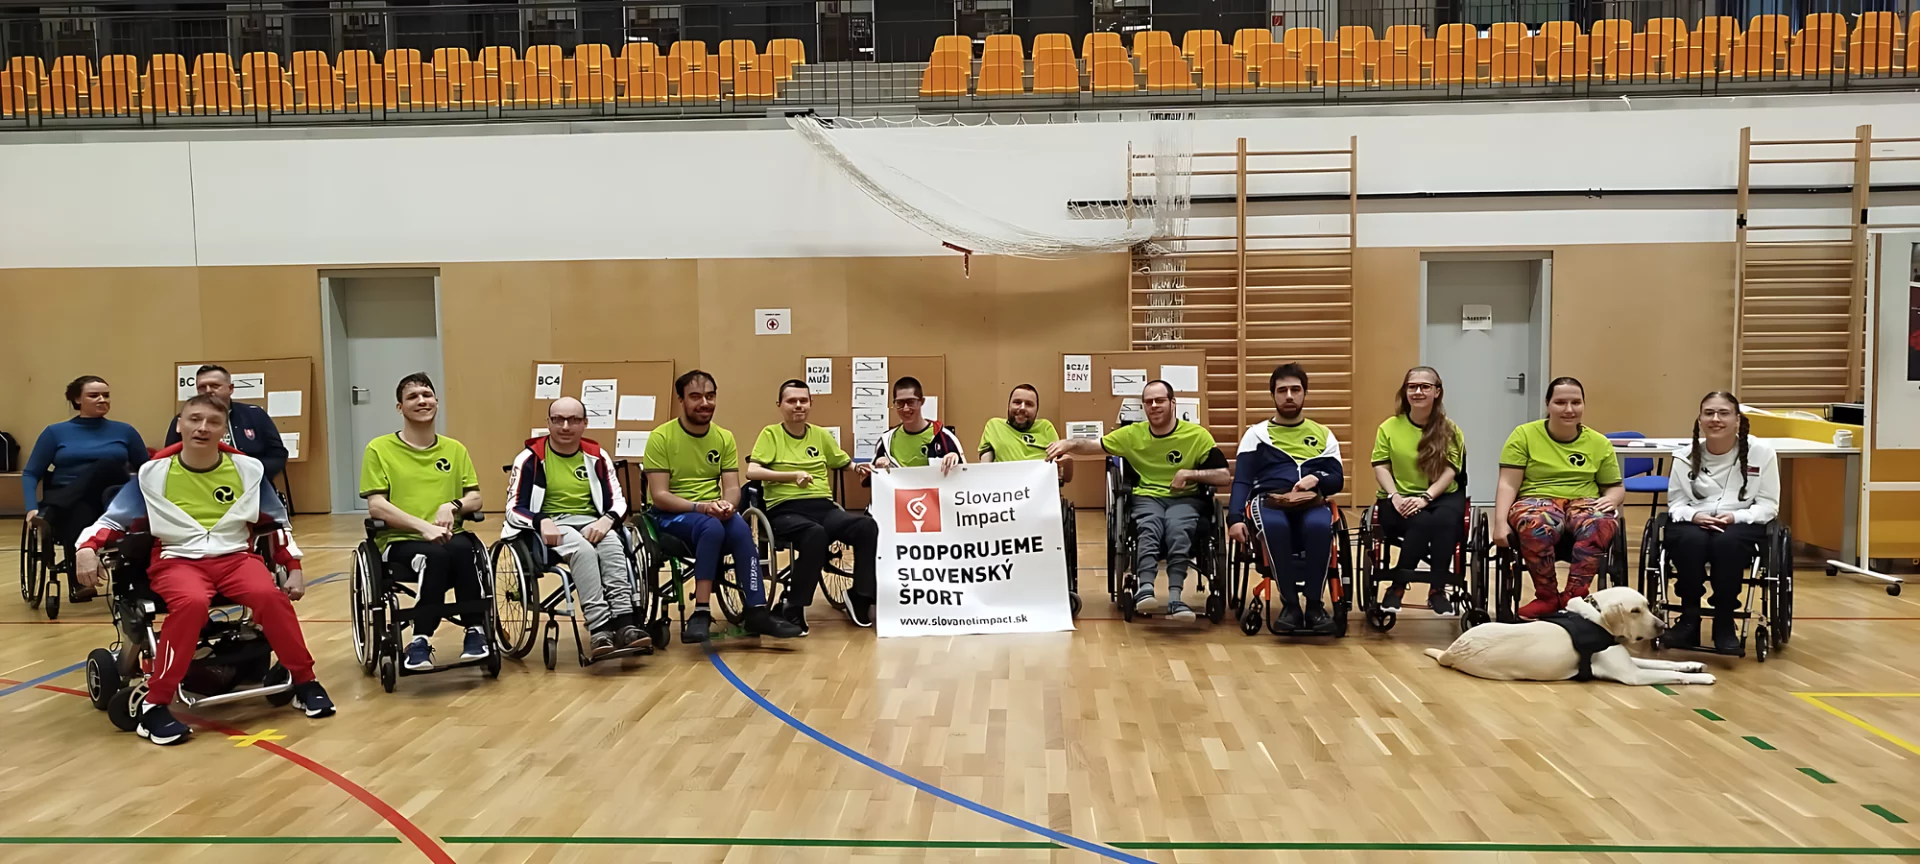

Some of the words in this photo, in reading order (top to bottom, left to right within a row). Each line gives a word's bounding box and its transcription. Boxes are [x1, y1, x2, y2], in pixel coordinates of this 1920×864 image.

[179, 377, 195, 387] BC
[537, 375, 561, 386] BC4
[954, 487, 1030, 505] Slovanet
[956, 507, 1016, 529] Impact
[896, 536, 1044, 560] PODPORUJEME
[898, 558, 1014, 584] SLOVENSKÝ
[899, 583, 964, 606] ŠPORT
[900, 613, 1028, 626] www.slovanetimpact.sk
